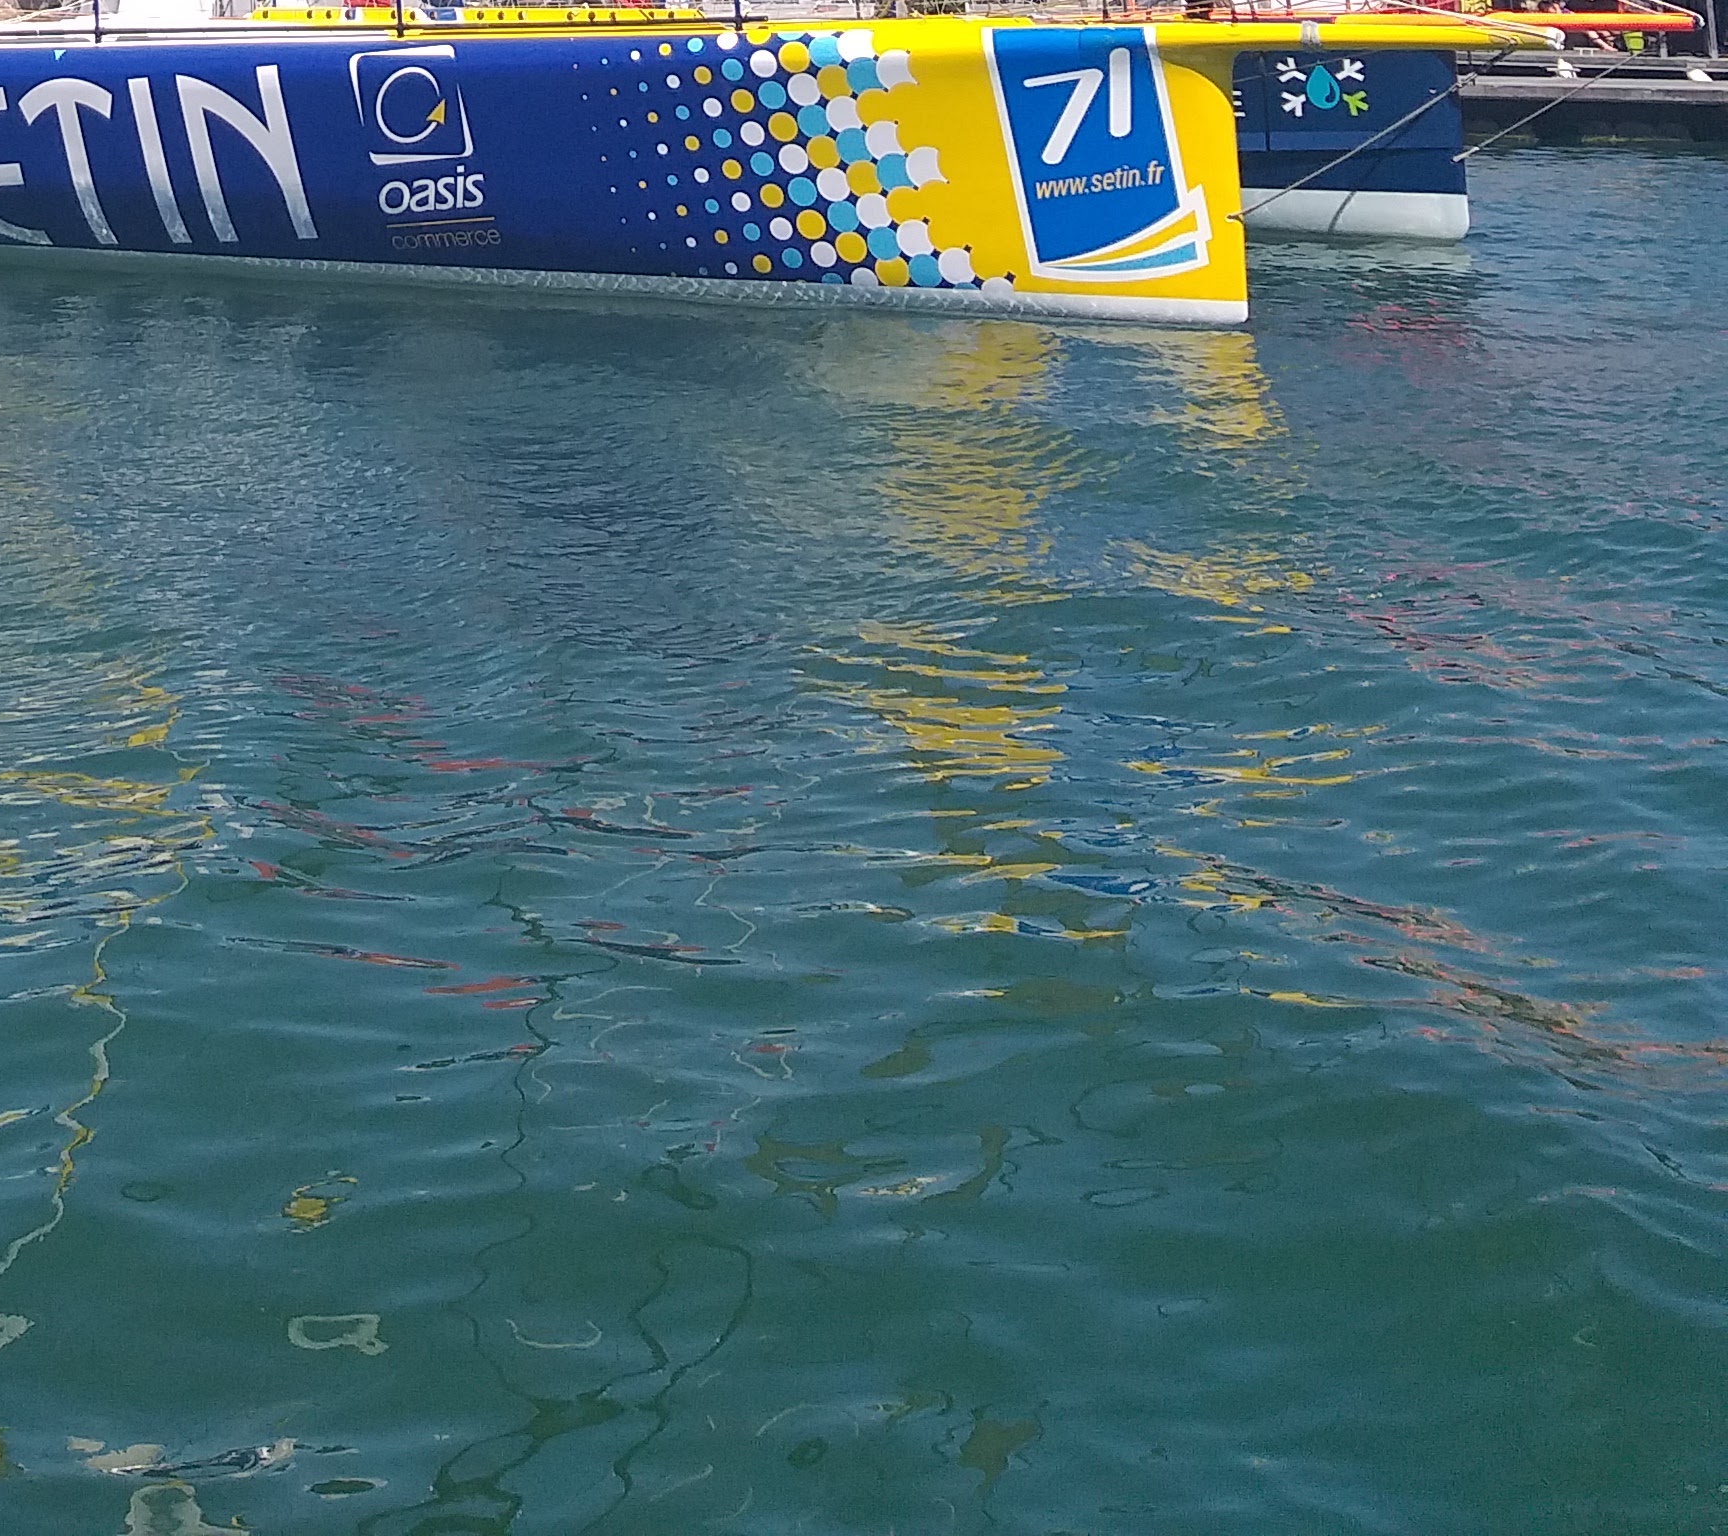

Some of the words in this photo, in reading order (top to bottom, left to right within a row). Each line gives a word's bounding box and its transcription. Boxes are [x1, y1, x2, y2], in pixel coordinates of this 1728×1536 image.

[378, 165, 485, 215] oasis
[1035, 159, 1166, 200] www.setin.fr
[391, 227, 503, 251] commerce
